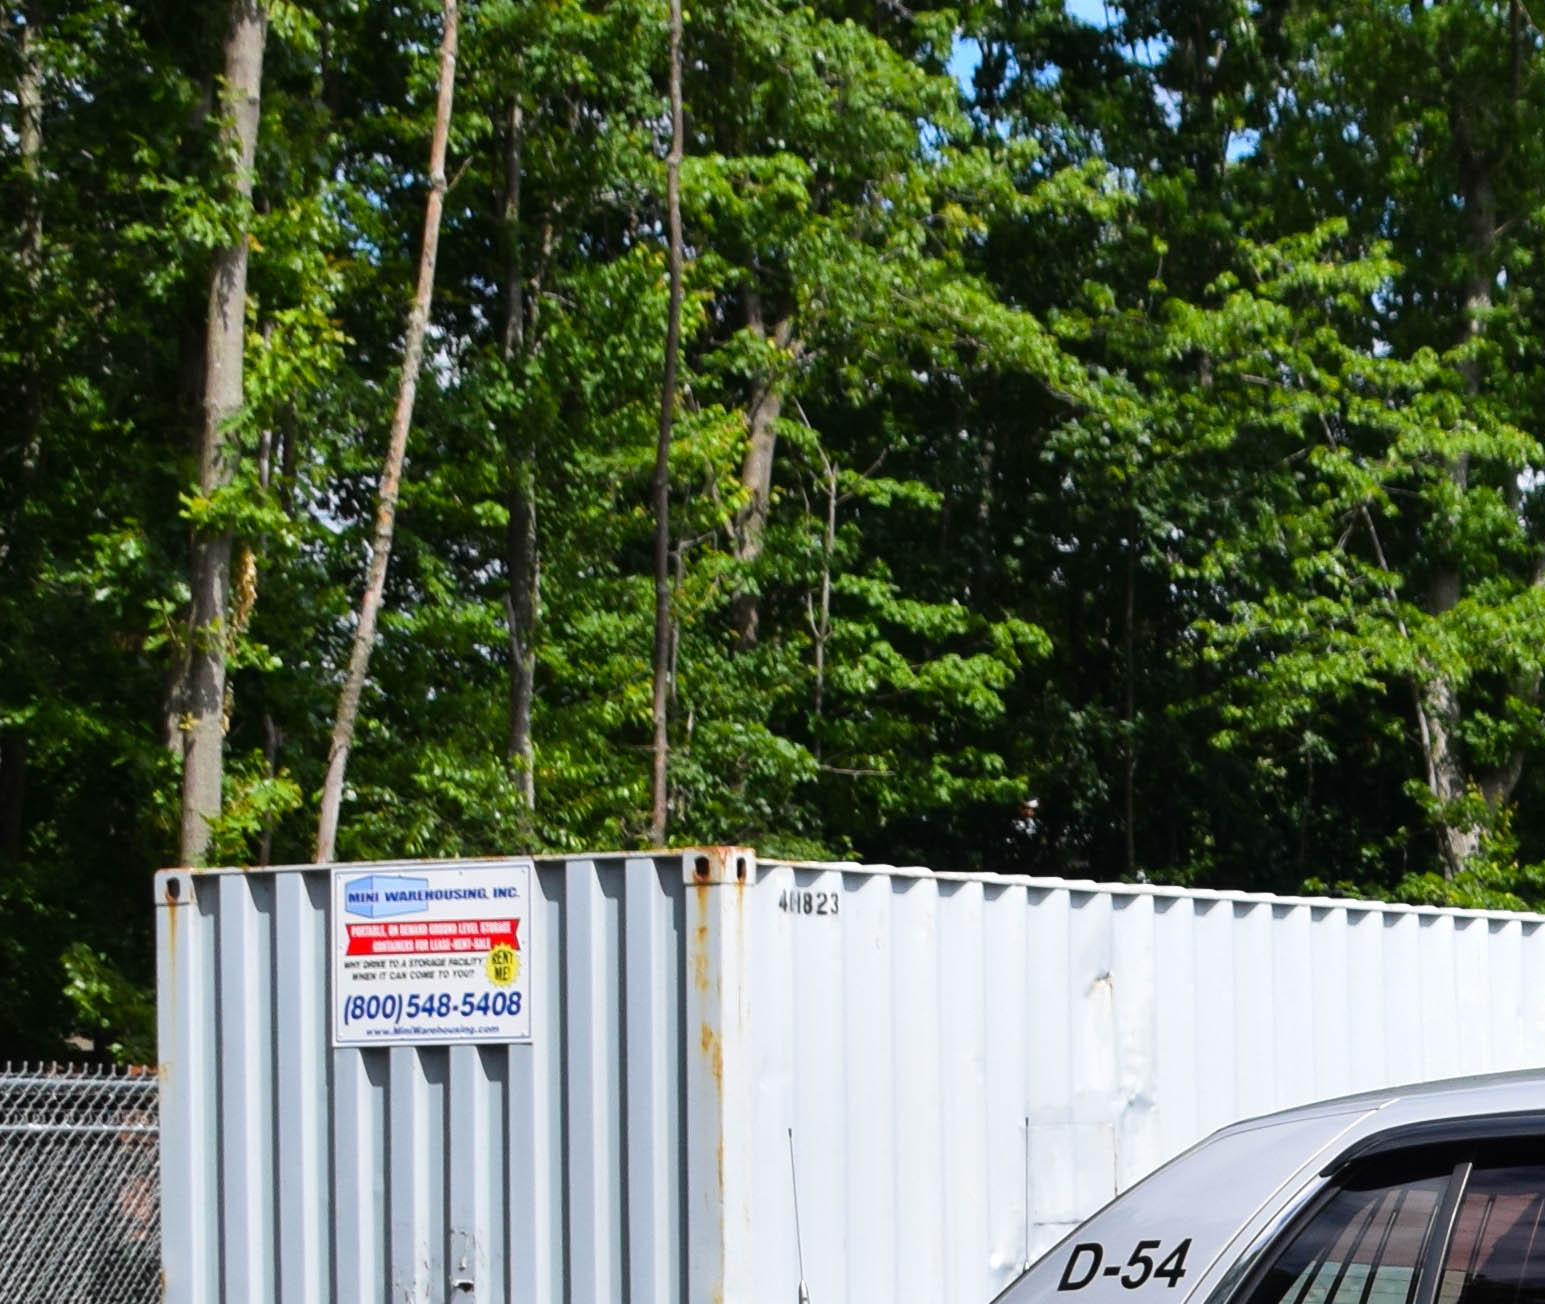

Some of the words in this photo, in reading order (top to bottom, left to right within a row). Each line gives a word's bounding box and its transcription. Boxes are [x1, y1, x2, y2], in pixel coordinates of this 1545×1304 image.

[348, 891, 380, 903] MINI
[493, 886, 521, 899] INC.
[389, 960, 399, 968] TO
[400, 960, 407, 968] A
[409, 958, 446, 968] STORAGE
[448, 956, 482, 967] FACILITY
[491, 951, 513, 965] RENT
[352, 972, 376, 981] WHEN
[379, 972, 387, 980] IT
[390, 971, 407, 980] CAN
[410, 970, 434, 980] COME
[438, 970, 450, 979] TO
[453, 969, 476, 979] YOU?
[1057, 1238, 1192, 1291] D-54
